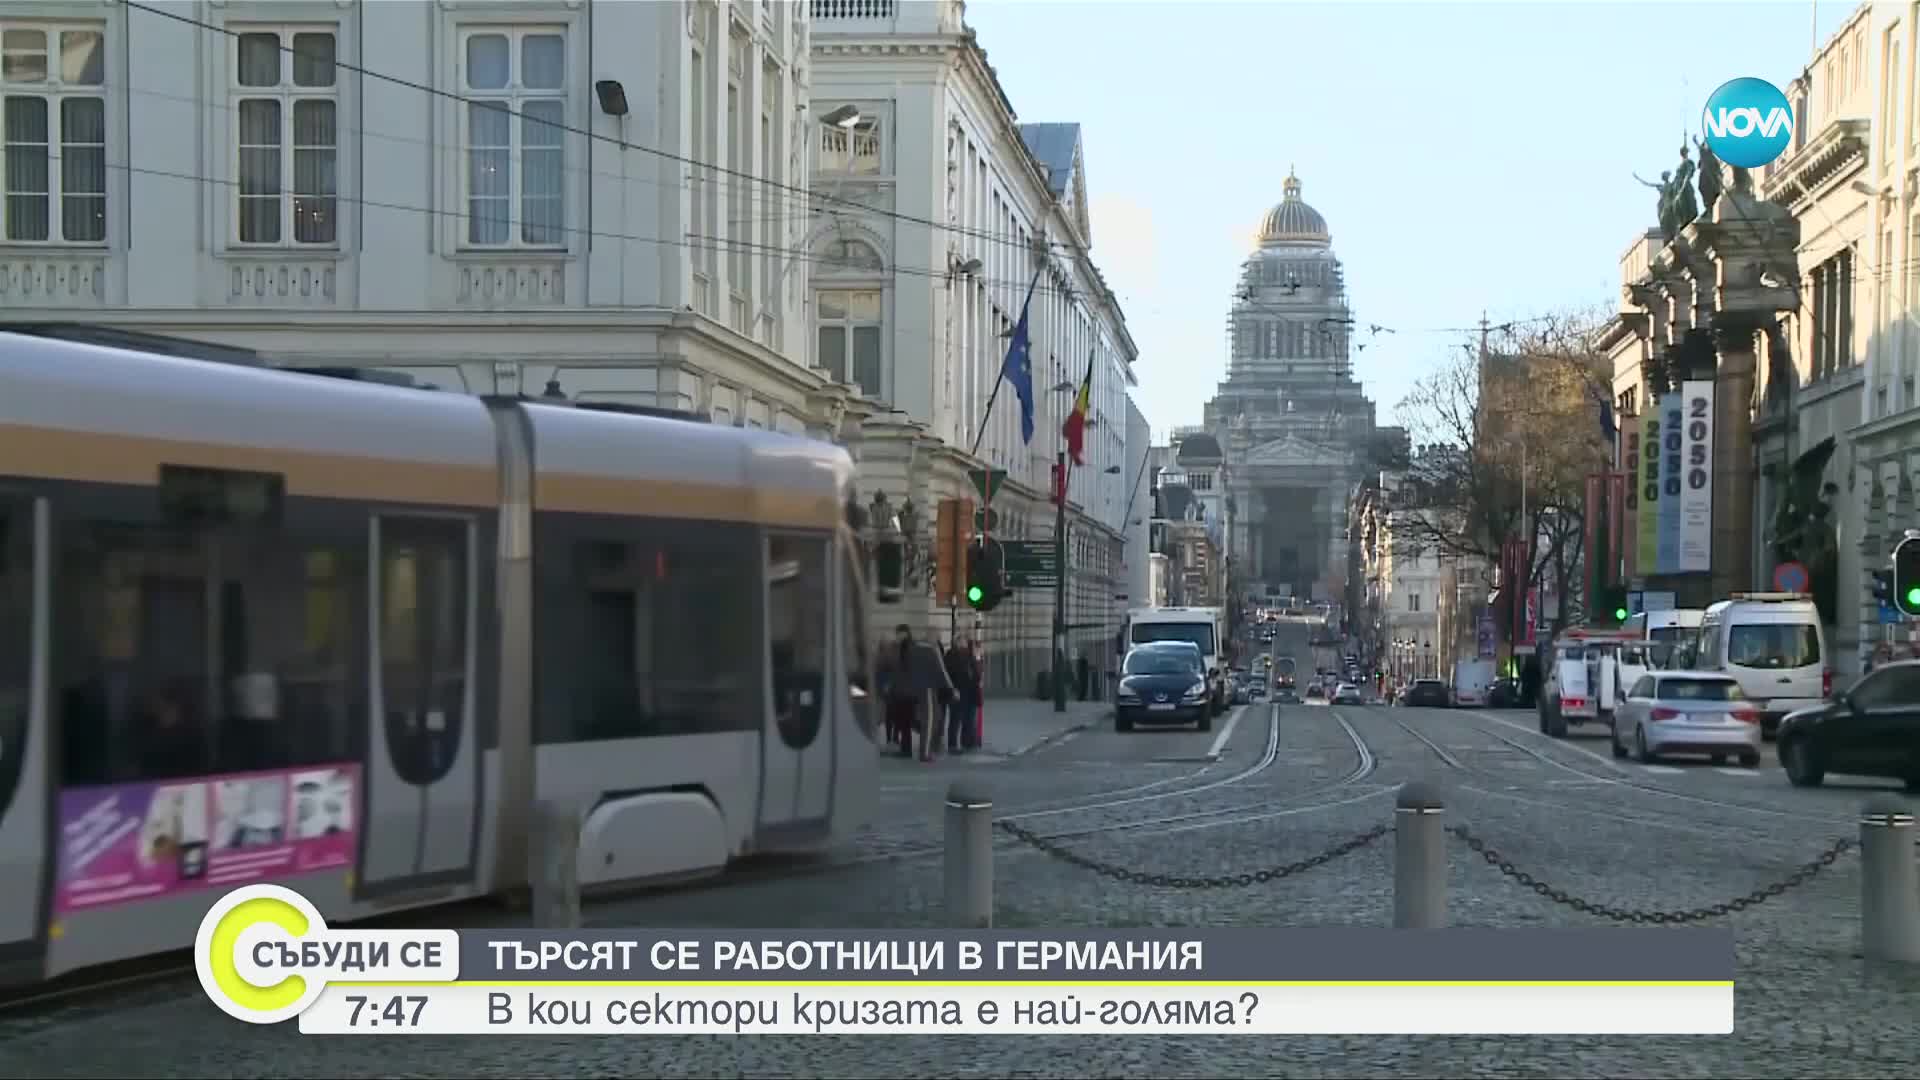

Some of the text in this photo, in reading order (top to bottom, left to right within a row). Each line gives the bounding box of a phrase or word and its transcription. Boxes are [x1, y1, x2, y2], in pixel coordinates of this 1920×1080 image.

[1645, 421, 1659, 501] 2050
[1666, 410, 1682, 495] 2050
[1689, 398, 1707, 489] 2050
